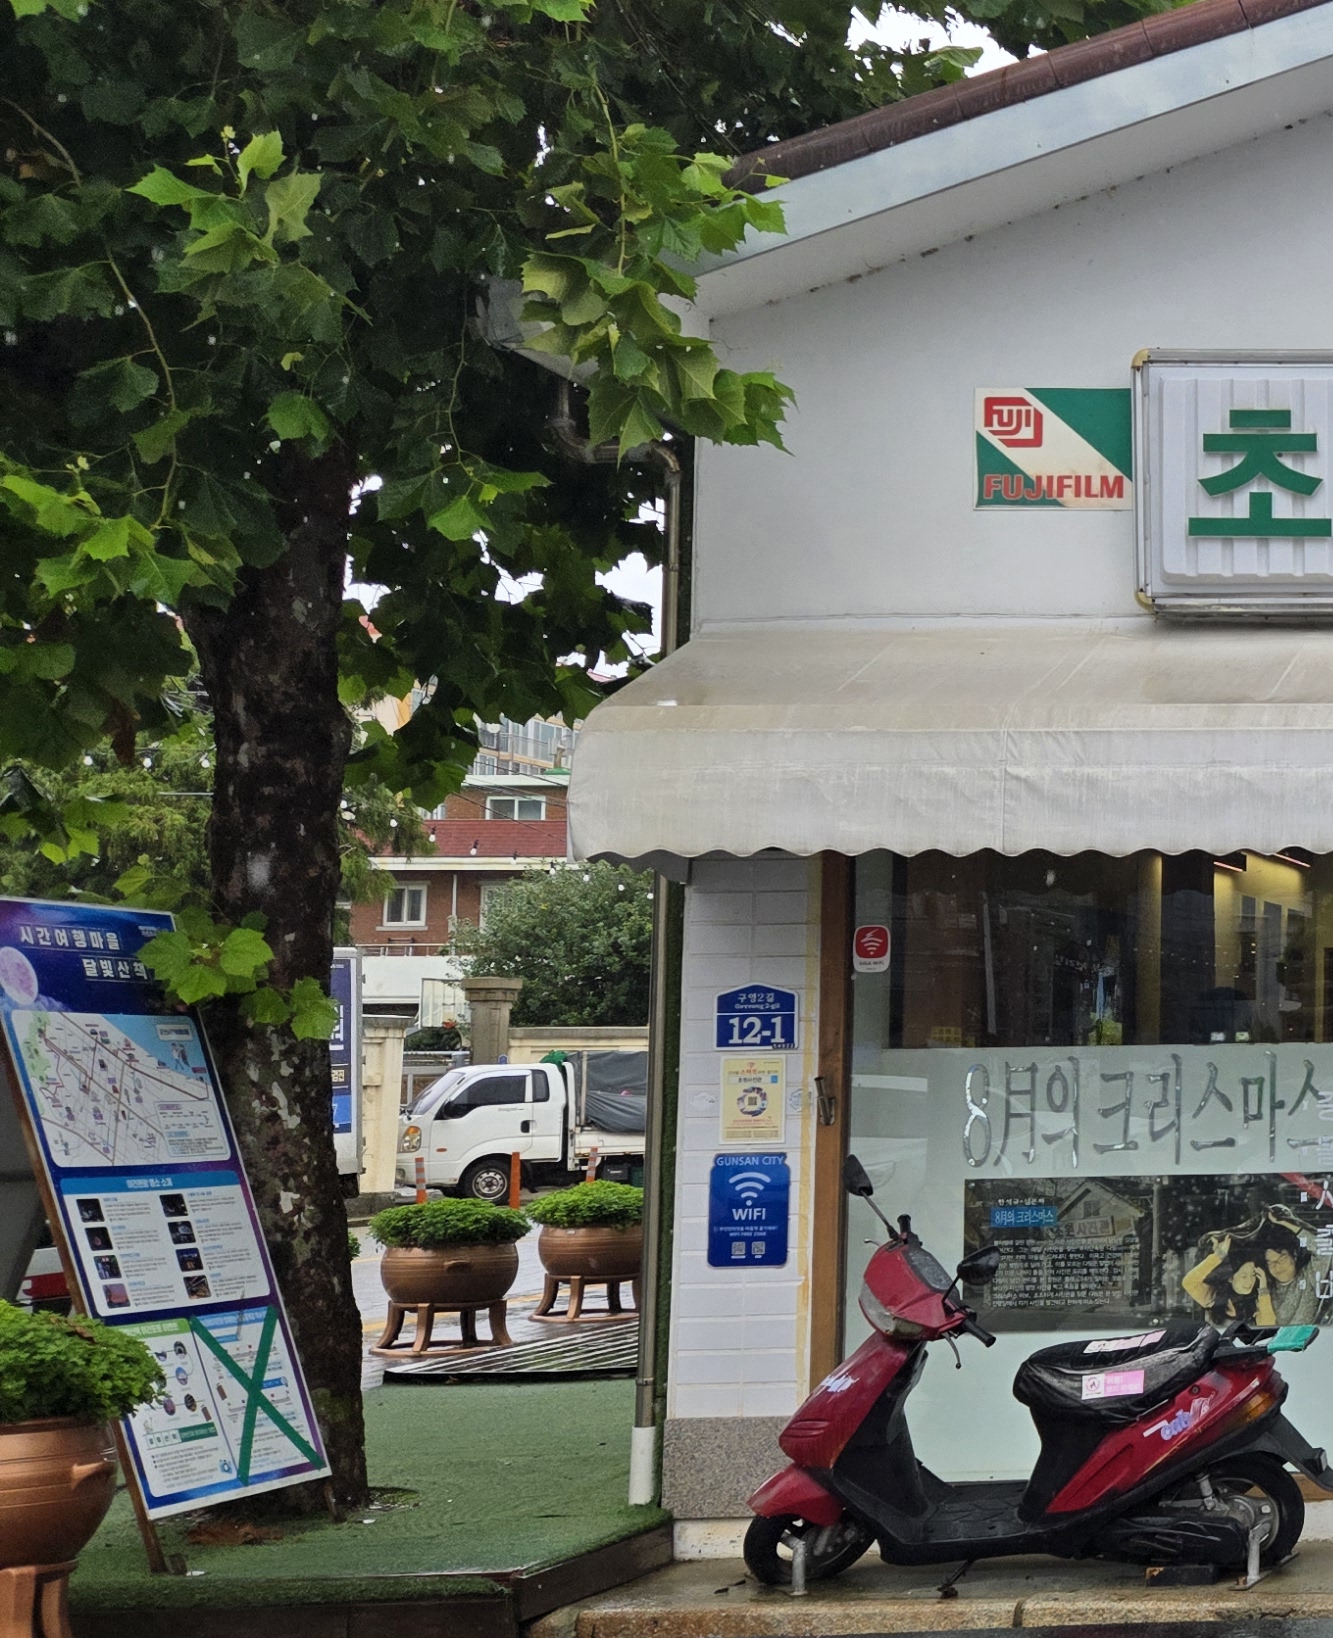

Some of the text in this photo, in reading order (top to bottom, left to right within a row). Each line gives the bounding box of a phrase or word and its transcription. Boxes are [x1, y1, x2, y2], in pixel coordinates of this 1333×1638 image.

[984, 397, 1043, 448] FUJI
[984, 473, 1124, 500] FUJIFILM
[20, 925, 121, 950] 시간여행마을
[82, 958, 148, 980] 달빛산책
[728, 1016, 785, 1044] 12-1
[1093, 1050, 1333, 1166] 크리스마스
[716, 1155, 784, 1166] GUNSAN CITY
[732, 1208, 766, 1221] WIFI
[1016, 1209, 1054, 1225] 크리스마스
